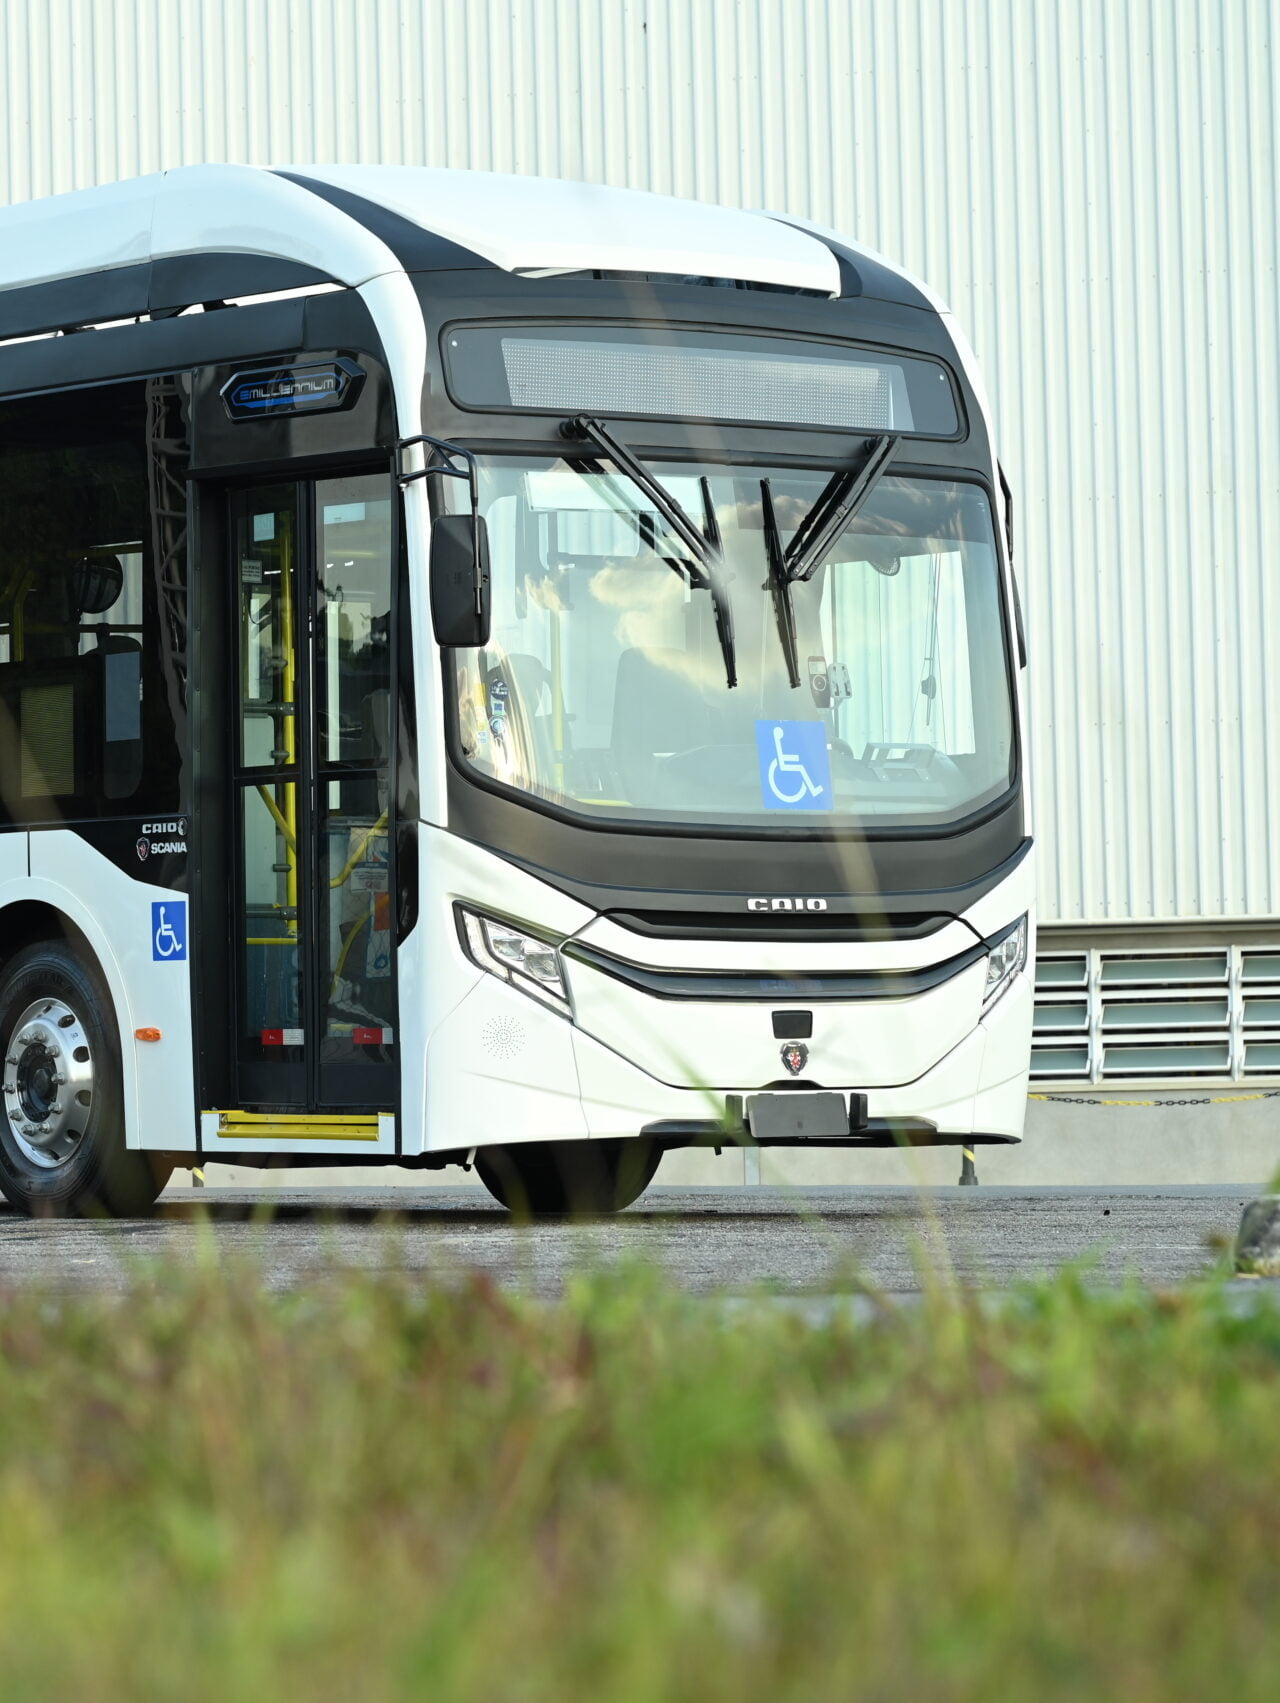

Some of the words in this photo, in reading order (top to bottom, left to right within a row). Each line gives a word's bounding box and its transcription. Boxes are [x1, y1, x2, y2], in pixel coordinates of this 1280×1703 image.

[142, 822, 178, 834] CAIO
[150, 841, 187, 854] SCANIA
[746, 898, 828, 911] CAIO
